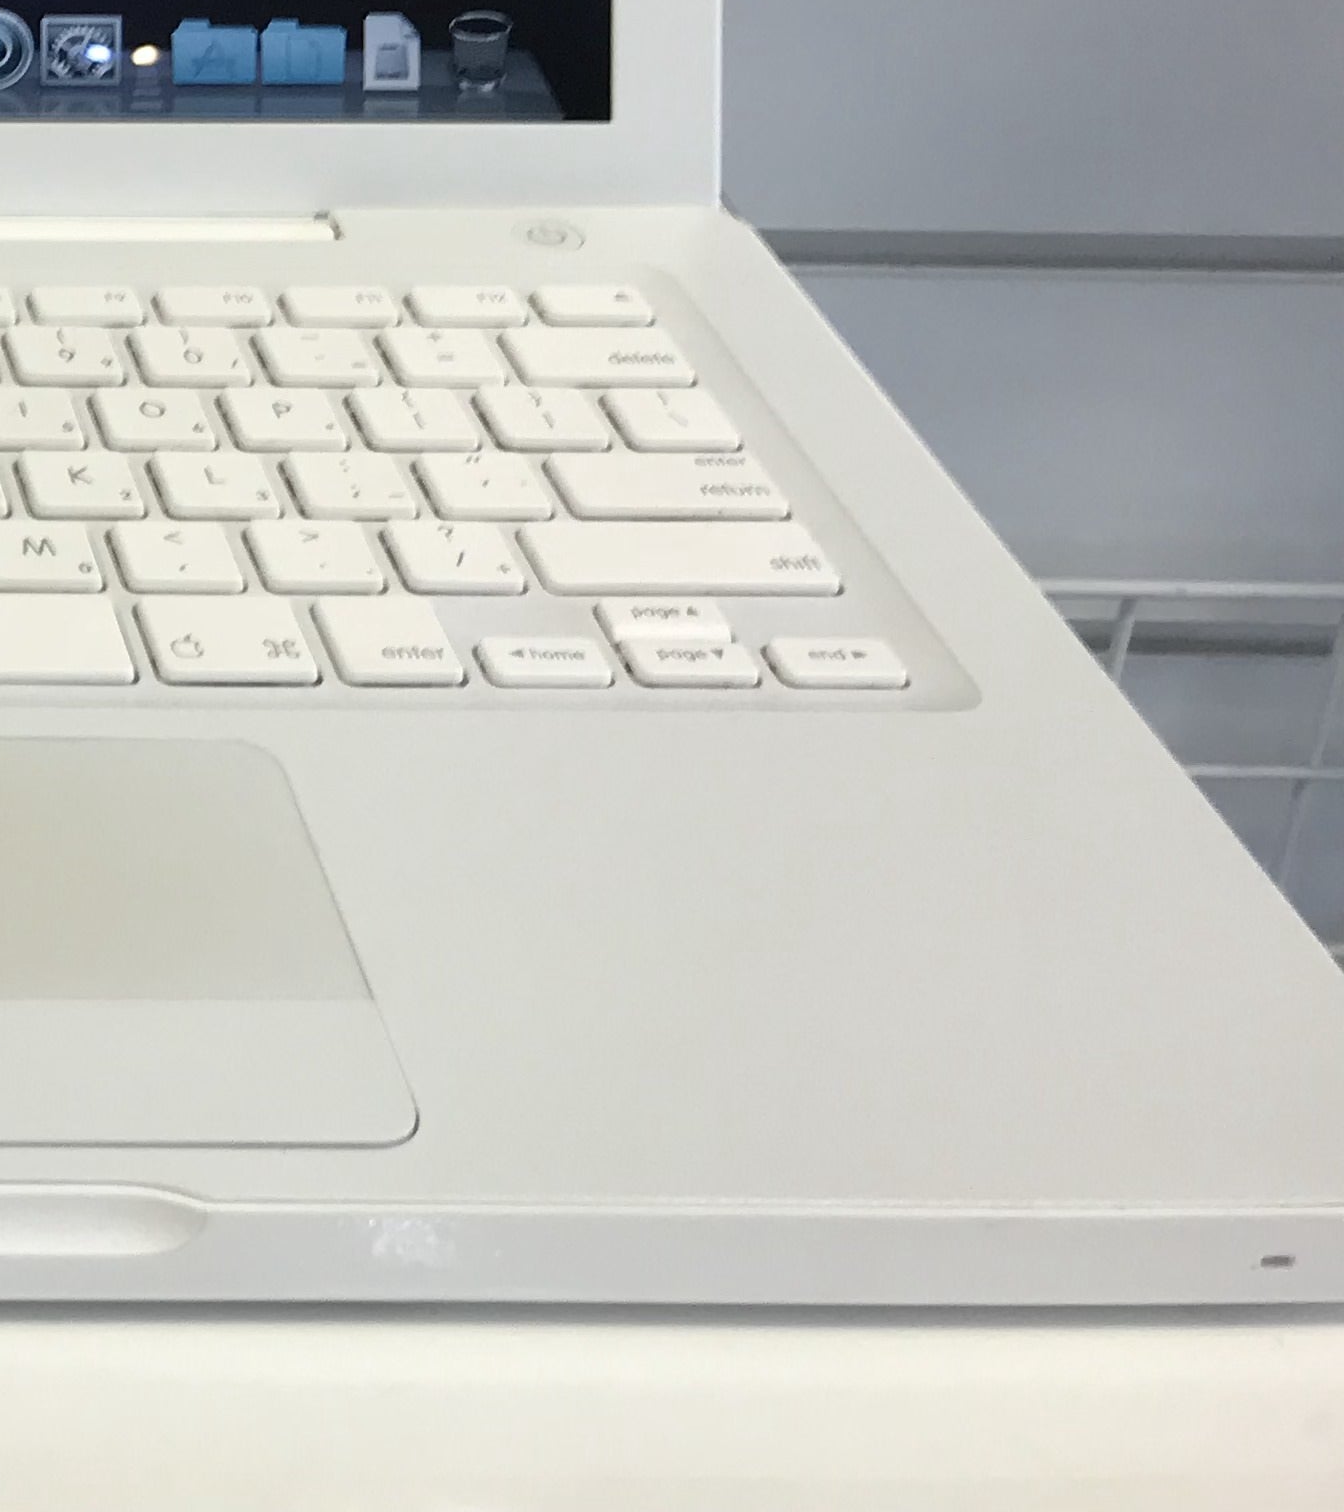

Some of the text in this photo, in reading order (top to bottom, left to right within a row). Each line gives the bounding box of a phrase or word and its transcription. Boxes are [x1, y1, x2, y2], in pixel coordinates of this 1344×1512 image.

[139, 401, 166, 417] O
[272, 402, 292, 419] P
[694, 454, 746, 466] enter
[68, 467, 91, 484] K
[204, 466, 224, 485] L
[700, 483, 770, 496] return
[22, 537, 56, 556] M
[770, 555, 821, 570] shift
[381, 646, 444, 660] enter
[529, 648, 585, 660] home
